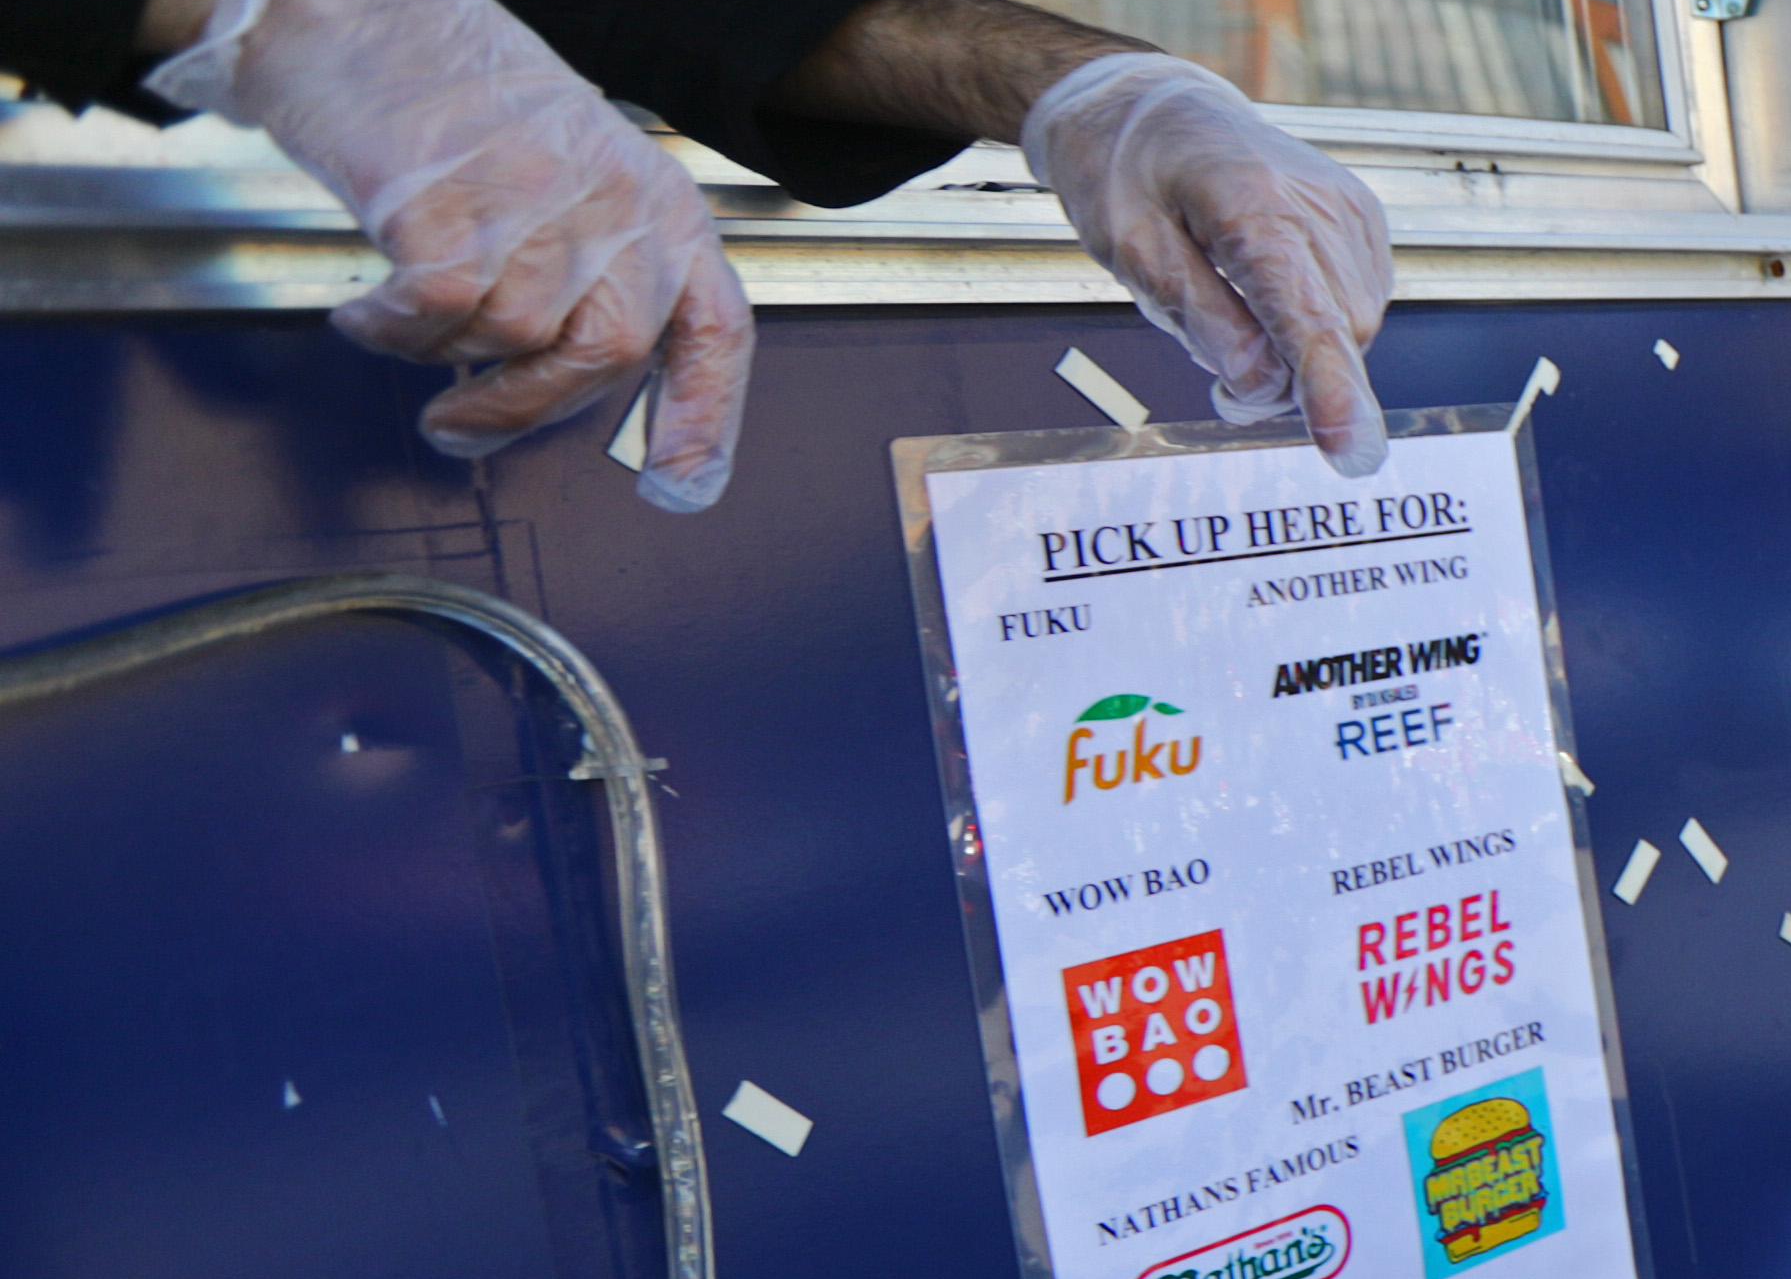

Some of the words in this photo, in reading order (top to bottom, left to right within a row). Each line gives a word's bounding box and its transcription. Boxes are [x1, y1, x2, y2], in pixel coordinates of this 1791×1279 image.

[1037, 521, 1161, 572] PICK
[1172, 514, 1230, 557] UP
[1243, 501, 1366, 549] HERE
[1373, 490, 1469, 534] FOR:
[1246, 565, 1390, 609] ANOTHER
[1393, 555, 1470, 587] WING
[999, 603, 1093, 643] FUKU
[1272, 646, 1403, 699] ANOTHER
[1406, 633, 1481, 675] WING
[1063, 717, 1203, 806] fuku
[1334, 703, 1454, 760] REEF
[1042, 873, 1134, 918] WOW
[1142, 859, 1211, 898] BAO
[1330, 852, 1425, 896] REBEL
[1427, 828, 1517, 869] WINGS
[1356, 888, 1512, 972] REBEL
[1076, 950, 1216, 1020] WOW
[1091, 997, 1223, 1066] BAO
[1289, 1094, 1340, 1126] Mr.
[1344, 1056, 1434, 1107] BEAST
[1440, 1021, 1547, 1076] BURGER
[1096, 1176, 1238, 1247] NATHANS
[1245, 1135, 1361, 1195] FAMOUS
[1440, 1170, 1541, 1233] BURGER
